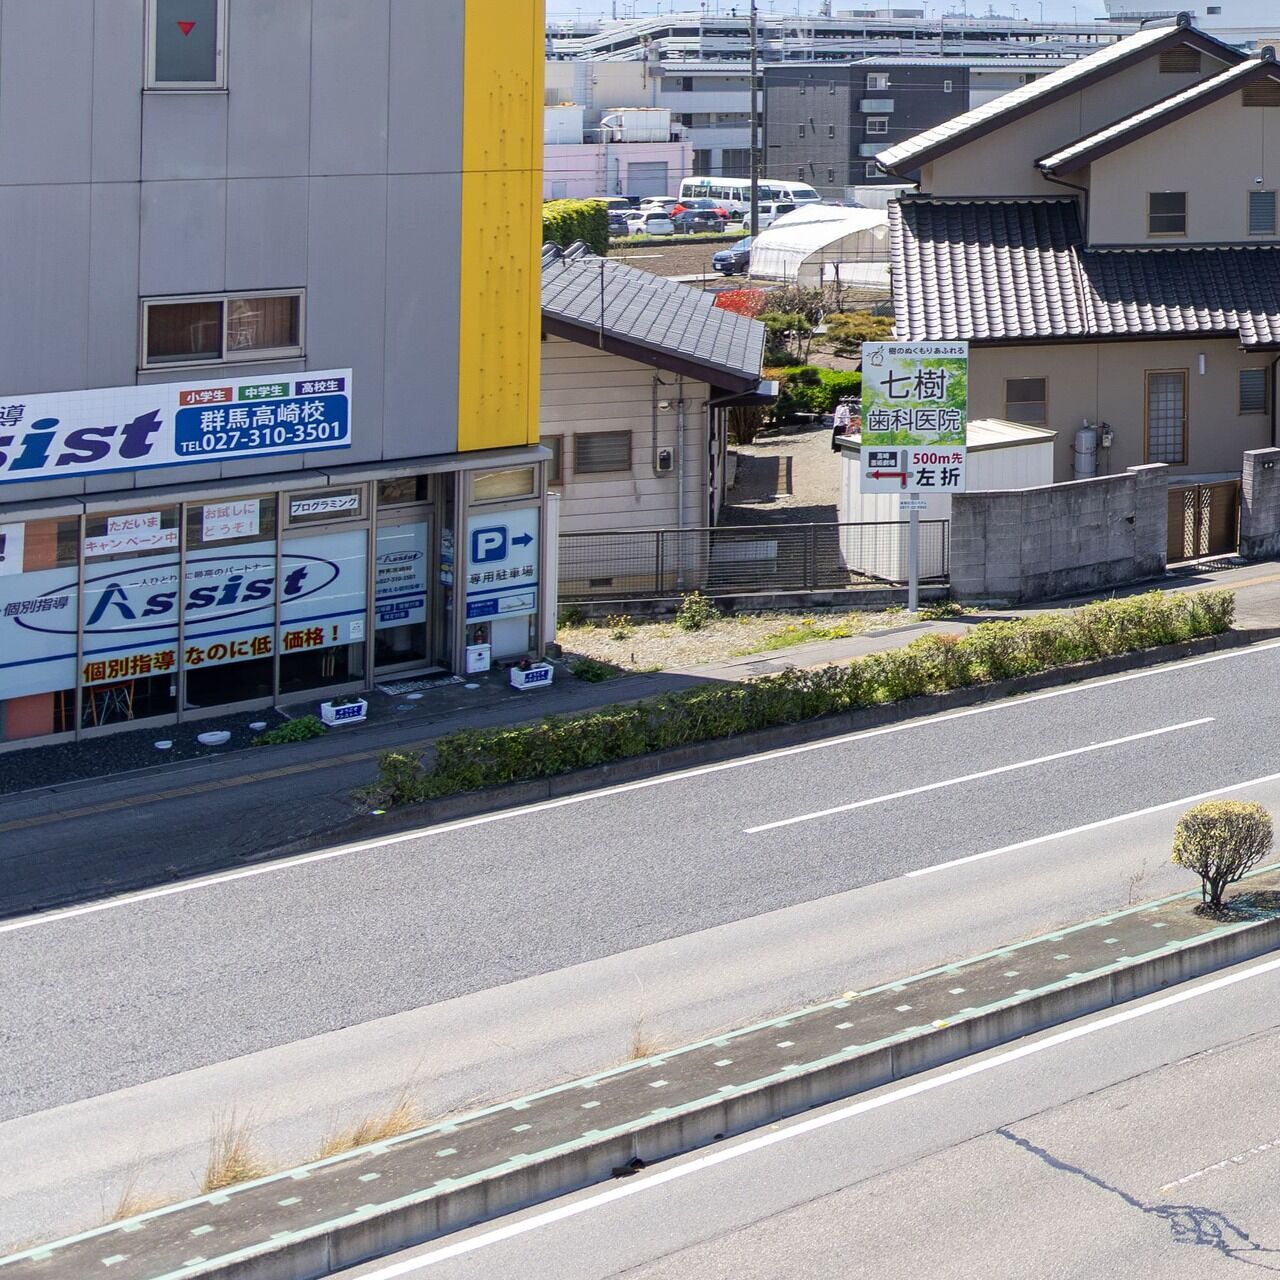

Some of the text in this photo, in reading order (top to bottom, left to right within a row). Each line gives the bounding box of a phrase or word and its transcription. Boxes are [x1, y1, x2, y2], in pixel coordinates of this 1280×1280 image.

[888, 347, 965, 355] 樹のぬくもりあふれる
[244, 385, 284, 398] 中学生
[301, 380, 339, 394] 高校生
[880, 369, 947, 400] 七樹
[186, 389, 226, 404] 小学生
[200, 400, 326, 432] 群馬高崎校
[868, 409, 960, 432] 歯科医院
[912, 452, 963, 465] 500m先
[915, 467, 961, 487] 左折
[291, 497, 358, 514] プログラミング
[109, 516, 159, 533] ただいま
[477, 531, 504, 560] P
[468, 565, 534, 585] 専用駐車場
